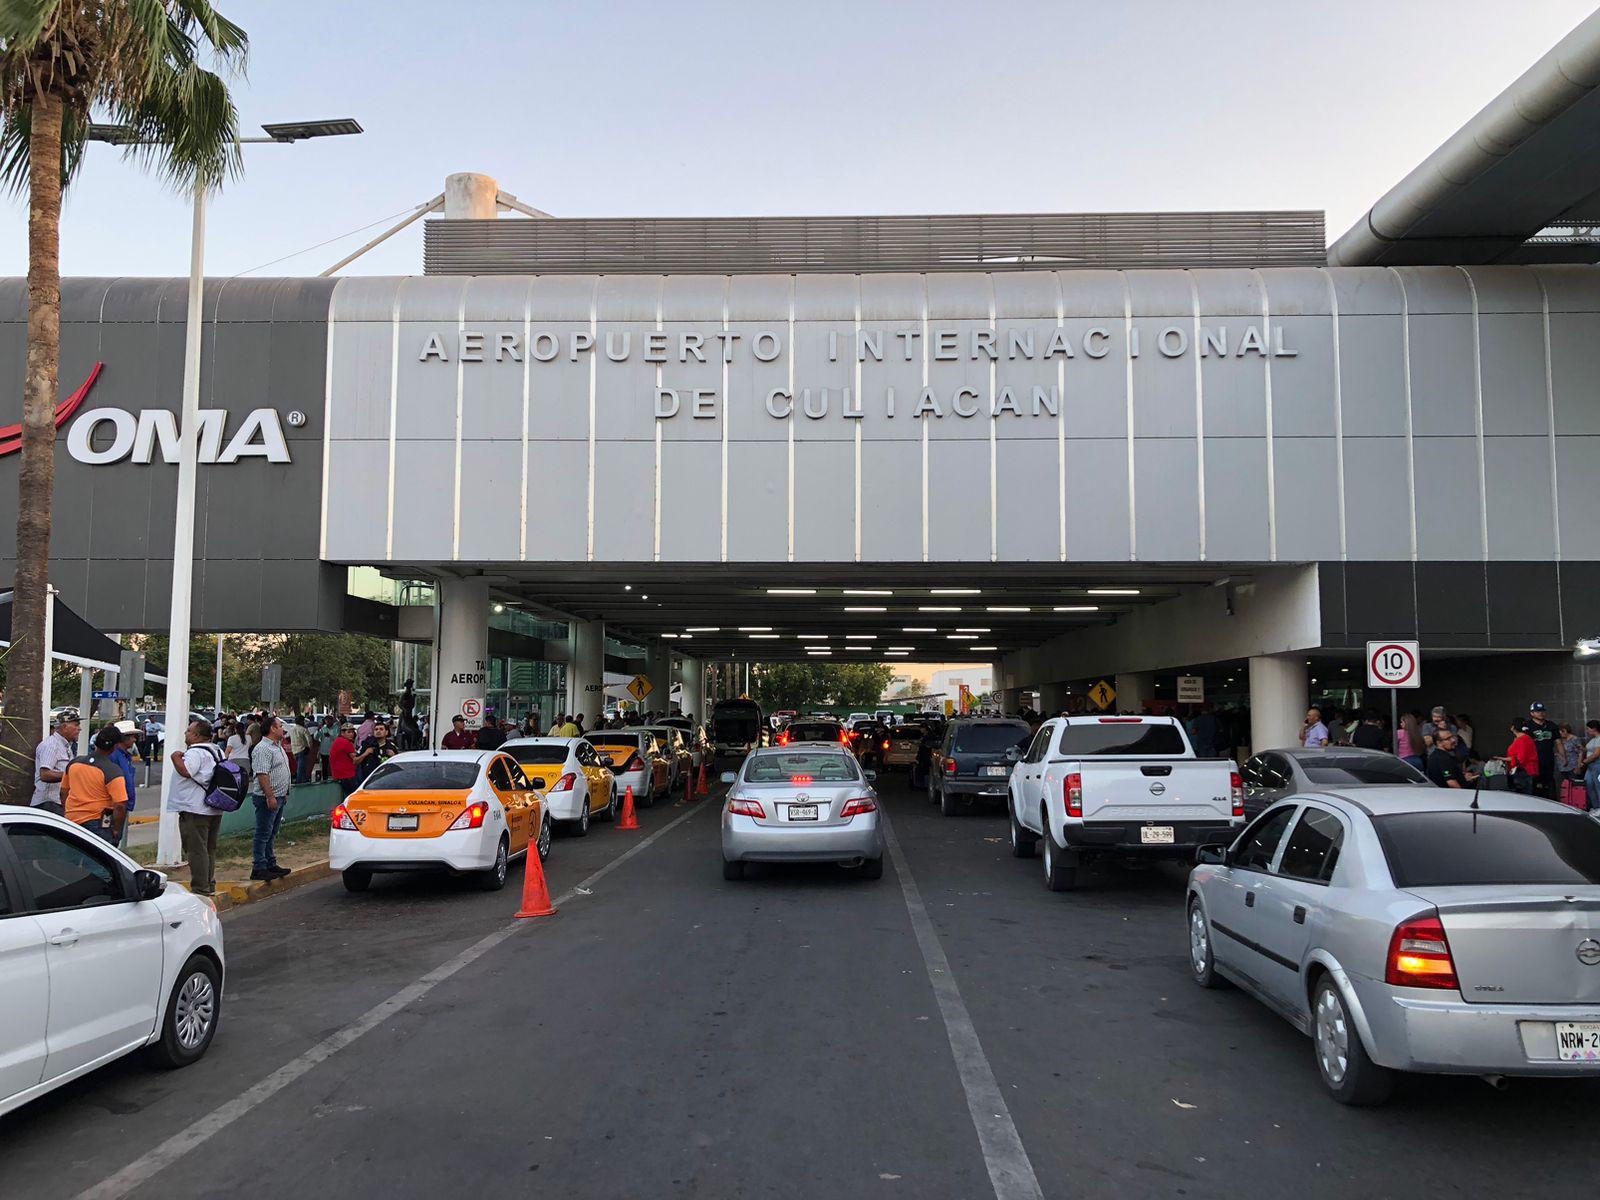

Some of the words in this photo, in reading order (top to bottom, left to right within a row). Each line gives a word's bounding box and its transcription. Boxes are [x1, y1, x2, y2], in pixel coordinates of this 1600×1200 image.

[418, 331, 782, 363] AEROPUERTO
[828, 325, 1299, 362] INTERNACIONAL
[655, 387, 716, 419] DE
[765, 385, 1060, 419] CULIACAN
[67, 407, 292, 465] OMA
[1383, 653, 1403, 670] 10
[1560, 1032, 1600, 1049] NRW-2
